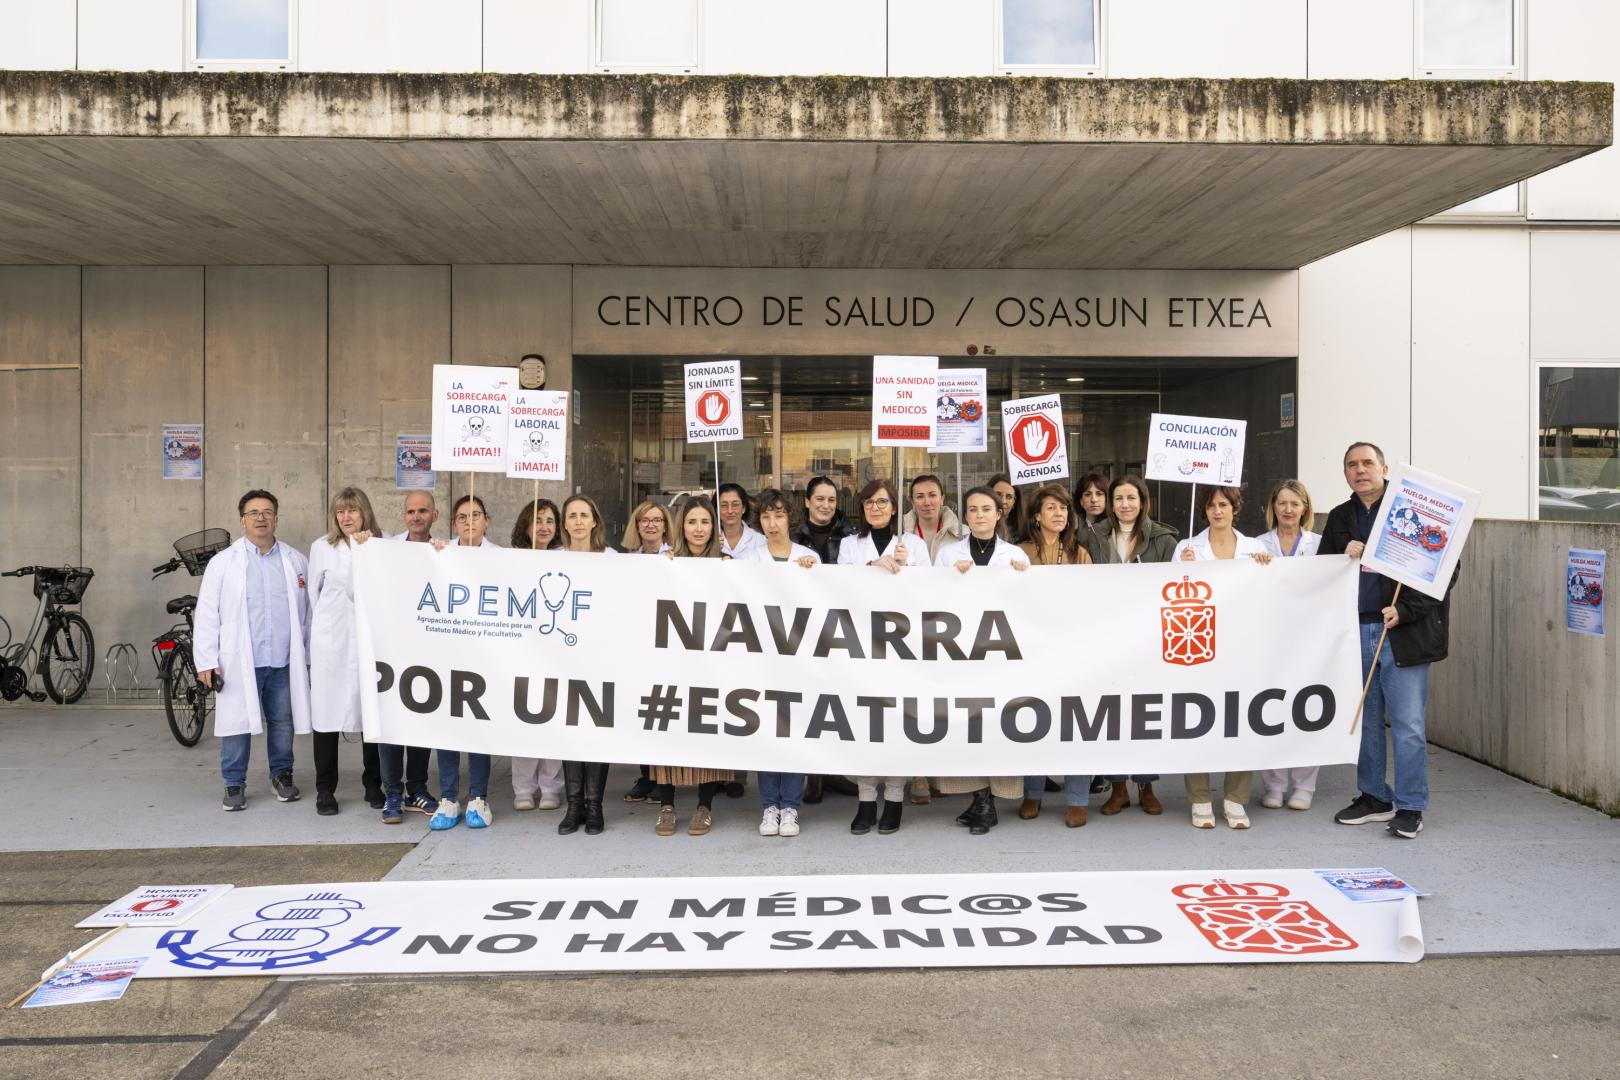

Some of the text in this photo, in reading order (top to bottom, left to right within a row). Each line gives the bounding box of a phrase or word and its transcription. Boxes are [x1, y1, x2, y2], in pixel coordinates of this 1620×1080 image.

[598, 295, 1272, 328] CENTRO DE SALUD / OSASUN ETXEA
[687, 365, 735, 377] JORNADAS
[452, 382, 464, 390] LA
[688, 378, 735, 390] SIN LÍMITE
[875, 376, 935, 385] UNA SANIDAD
[446, 392, 507, 402] SOBRECARGA
[896, 390, 913, 399] SIN
[516, 397, 526, 405] LA
[451, 404, 502, 415] LABORAL
[510, 407, 566, 417] SOBRECARGA
[882, 405, 927, 415] MEDICOS
[1004, 401, 1060, 416] SOBRECARGA
[514, 419, 560, 430] LABORAL
[1159, 422, 1238, 437] CONCILIACIÓN
[689, 427, 739, 438] ESCLAVITUD
[1165, 438, 1217, 452] FAMILIAR
[1016, 464, 1062, 479] AGENDAS
[1402, 487, 1428, 502] HUELGA
[416, 615, 452, 625] Agrupación
[462, 619, 510, 629] Profesionales
[510, 622, 522, 630] por
[425, 625, 523, 638] Estatuto Médico y Facultativo
[655, 599, 1023, 661] NAVARRA
[513, 676, 615, 728] UN
[637, 683, 1336, 745] #ESTATUTOMEDICO
[483, 891, 1087, 921] SIN MÉDIC@S
[402, 925, 1163, 955] NO HAY SANIDAD
